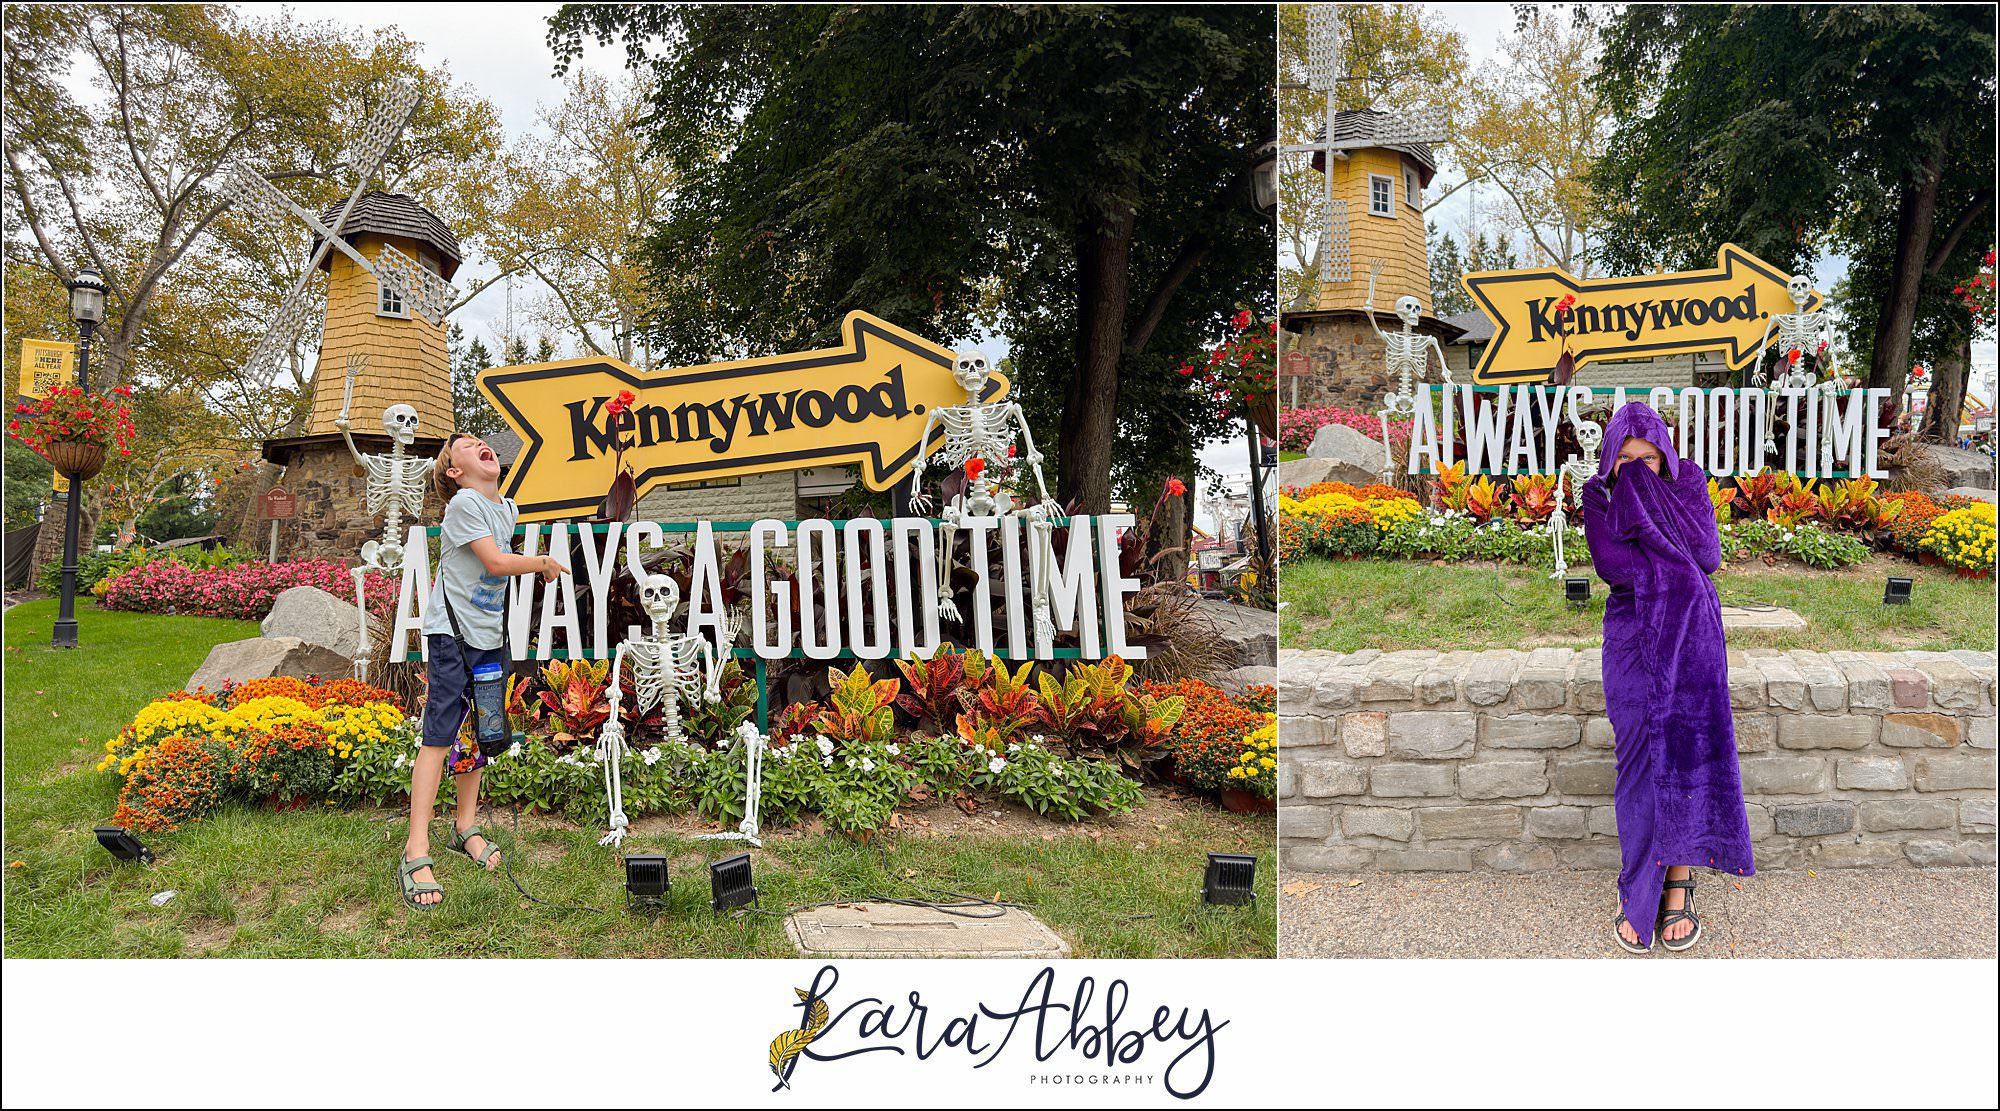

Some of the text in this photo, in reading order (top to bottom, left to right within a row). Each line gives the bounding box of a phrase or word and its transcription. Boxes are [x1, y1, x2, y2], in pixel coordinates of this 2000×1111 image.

[1524, 283, 1769, 343] Kennywood.
[563, 363, 926, 461] Kennywood.
[1777, 387, 1890, 479] TIME
[390, 514, 1147, 663] AAYS A GOOD TIME
